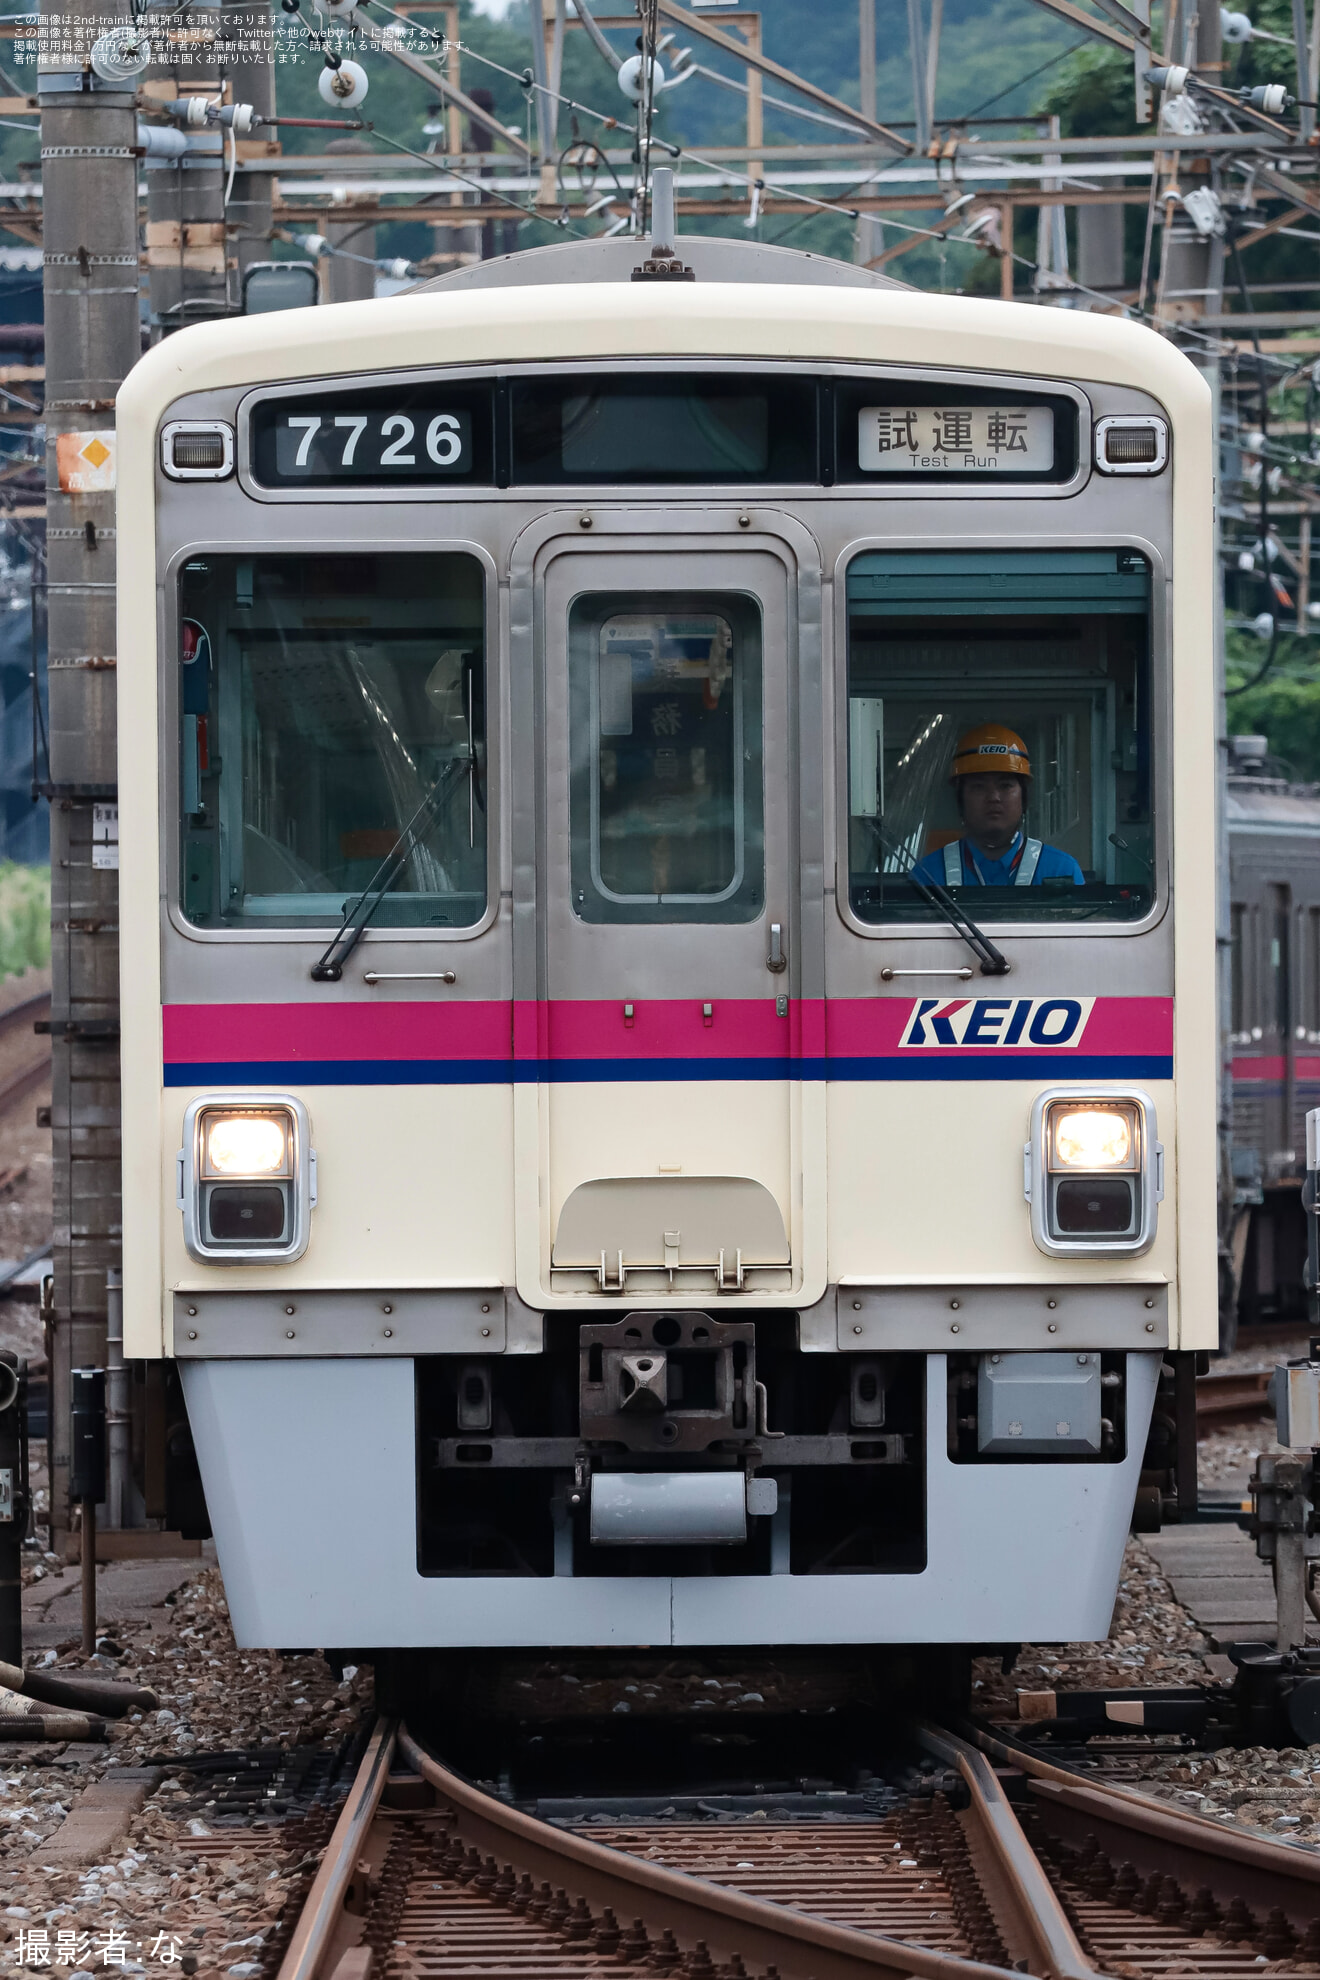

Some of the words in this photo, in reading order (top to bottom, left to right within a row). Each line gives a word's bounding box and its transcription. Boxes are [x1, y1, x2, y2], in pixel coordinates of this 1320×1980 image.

[288, 414, 462, 465] 7726
[877, 411, 1028, 453] 試運転
[909, 454, 949, 468] Test
[964, 454, 998, 468] Run
[980, 745, 1007, 753] KEIO
[906, 1000, 1082, 1045] KEIO
